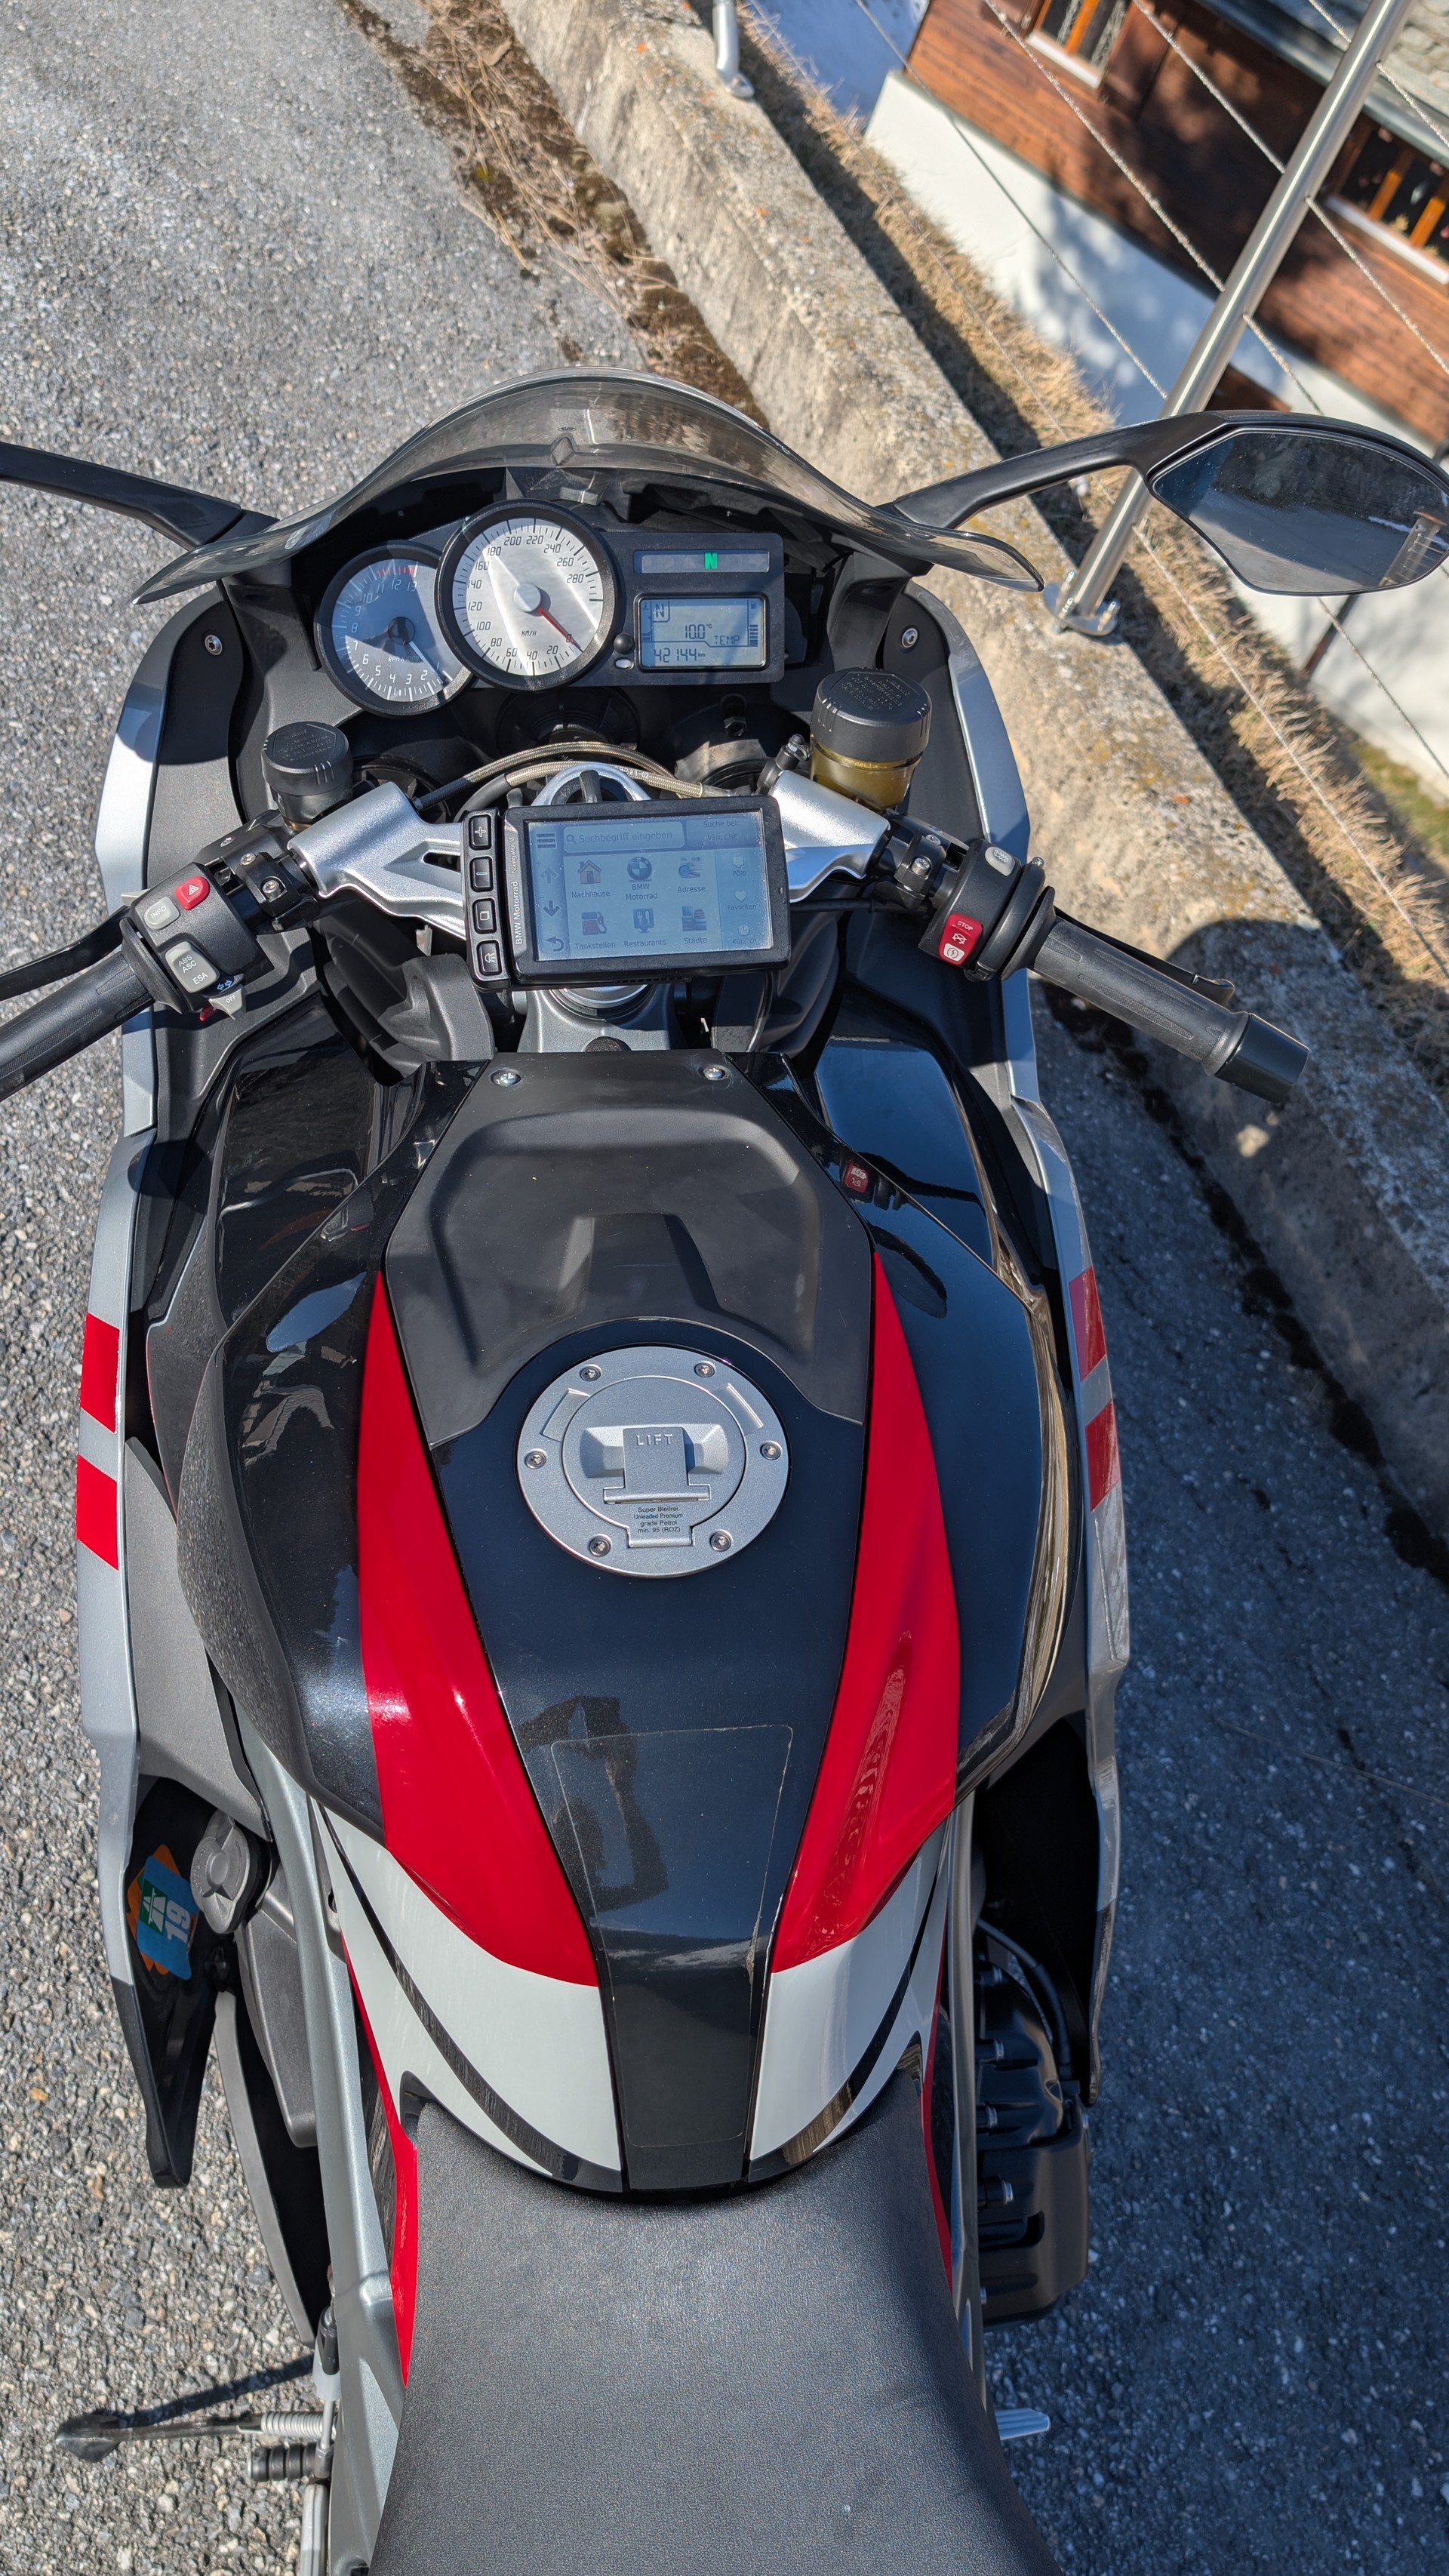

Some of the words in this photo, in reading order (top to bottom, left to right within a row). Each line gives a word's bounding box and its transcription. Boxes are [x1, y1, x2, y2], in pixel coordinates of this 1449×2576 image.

[504, 537, 521, 546] 200
[526, 536, 543, 544] 220
[487, 546, 501, 556] 180
[544, 544, 561, 553] 240
[557, 558, 574, 567] 260
[704, 552, 718, 569] N
[475, 561, 489, 571] 160
[567, 574, 583, 583] 280
[392, 579, 401, 590] 12
[407, 581, 417, 592] 13
[467, 580, 481, 589] 140
[363, 593, 373, 604] 10
[355, 605, 361, 616] 9
[468, 602, 482, 611] 120
[655, 603, 665, 618] N
[351, 623, 358, 633] 8
[476, 621, 491, 630] 100
[352, 640, 358, 650] 7
[491, 638, 502, 647] 80
[714, 635, 740, 645] TEMP
[506, 648, 518, 657] 60
[546, 645, 558, 654] 20
[362, 654, 369, 665] 6
[527, 651, 538, 660] 40
[375, 665, 381, 676] 5
[420, 669, 428, 680] 2
[389, 673, 396, 683] 4
[405, 673, 412, 684] 3
[579, 833, 630, 844] Suchbegriff
[632, 831, 672, 842] eingeben
[677, 885, 706, 894] Adresse
[511, 881, 520, 919] Motorrad
[571, 891, 611, 899] Nachhause
[626, 892, 658, 900] Motorrad
[150, 906, 167, 919] INFO
[957, 920, 974, 931] STOP
[514, 921, 522, 944] BMW
[575, 941, 616, 950] Tankstellen
[624, 939, 666, 947] Restaurants
[178, 954, 192, 968] ABS
[182, 960, 197, 974] ASC
[192, 972, 208, 985] ESA
[226, 994, 236, 1004] OFF
[636, 1433, 673, 1445] LIFT
[165, 1899, 191, 1944] 19
